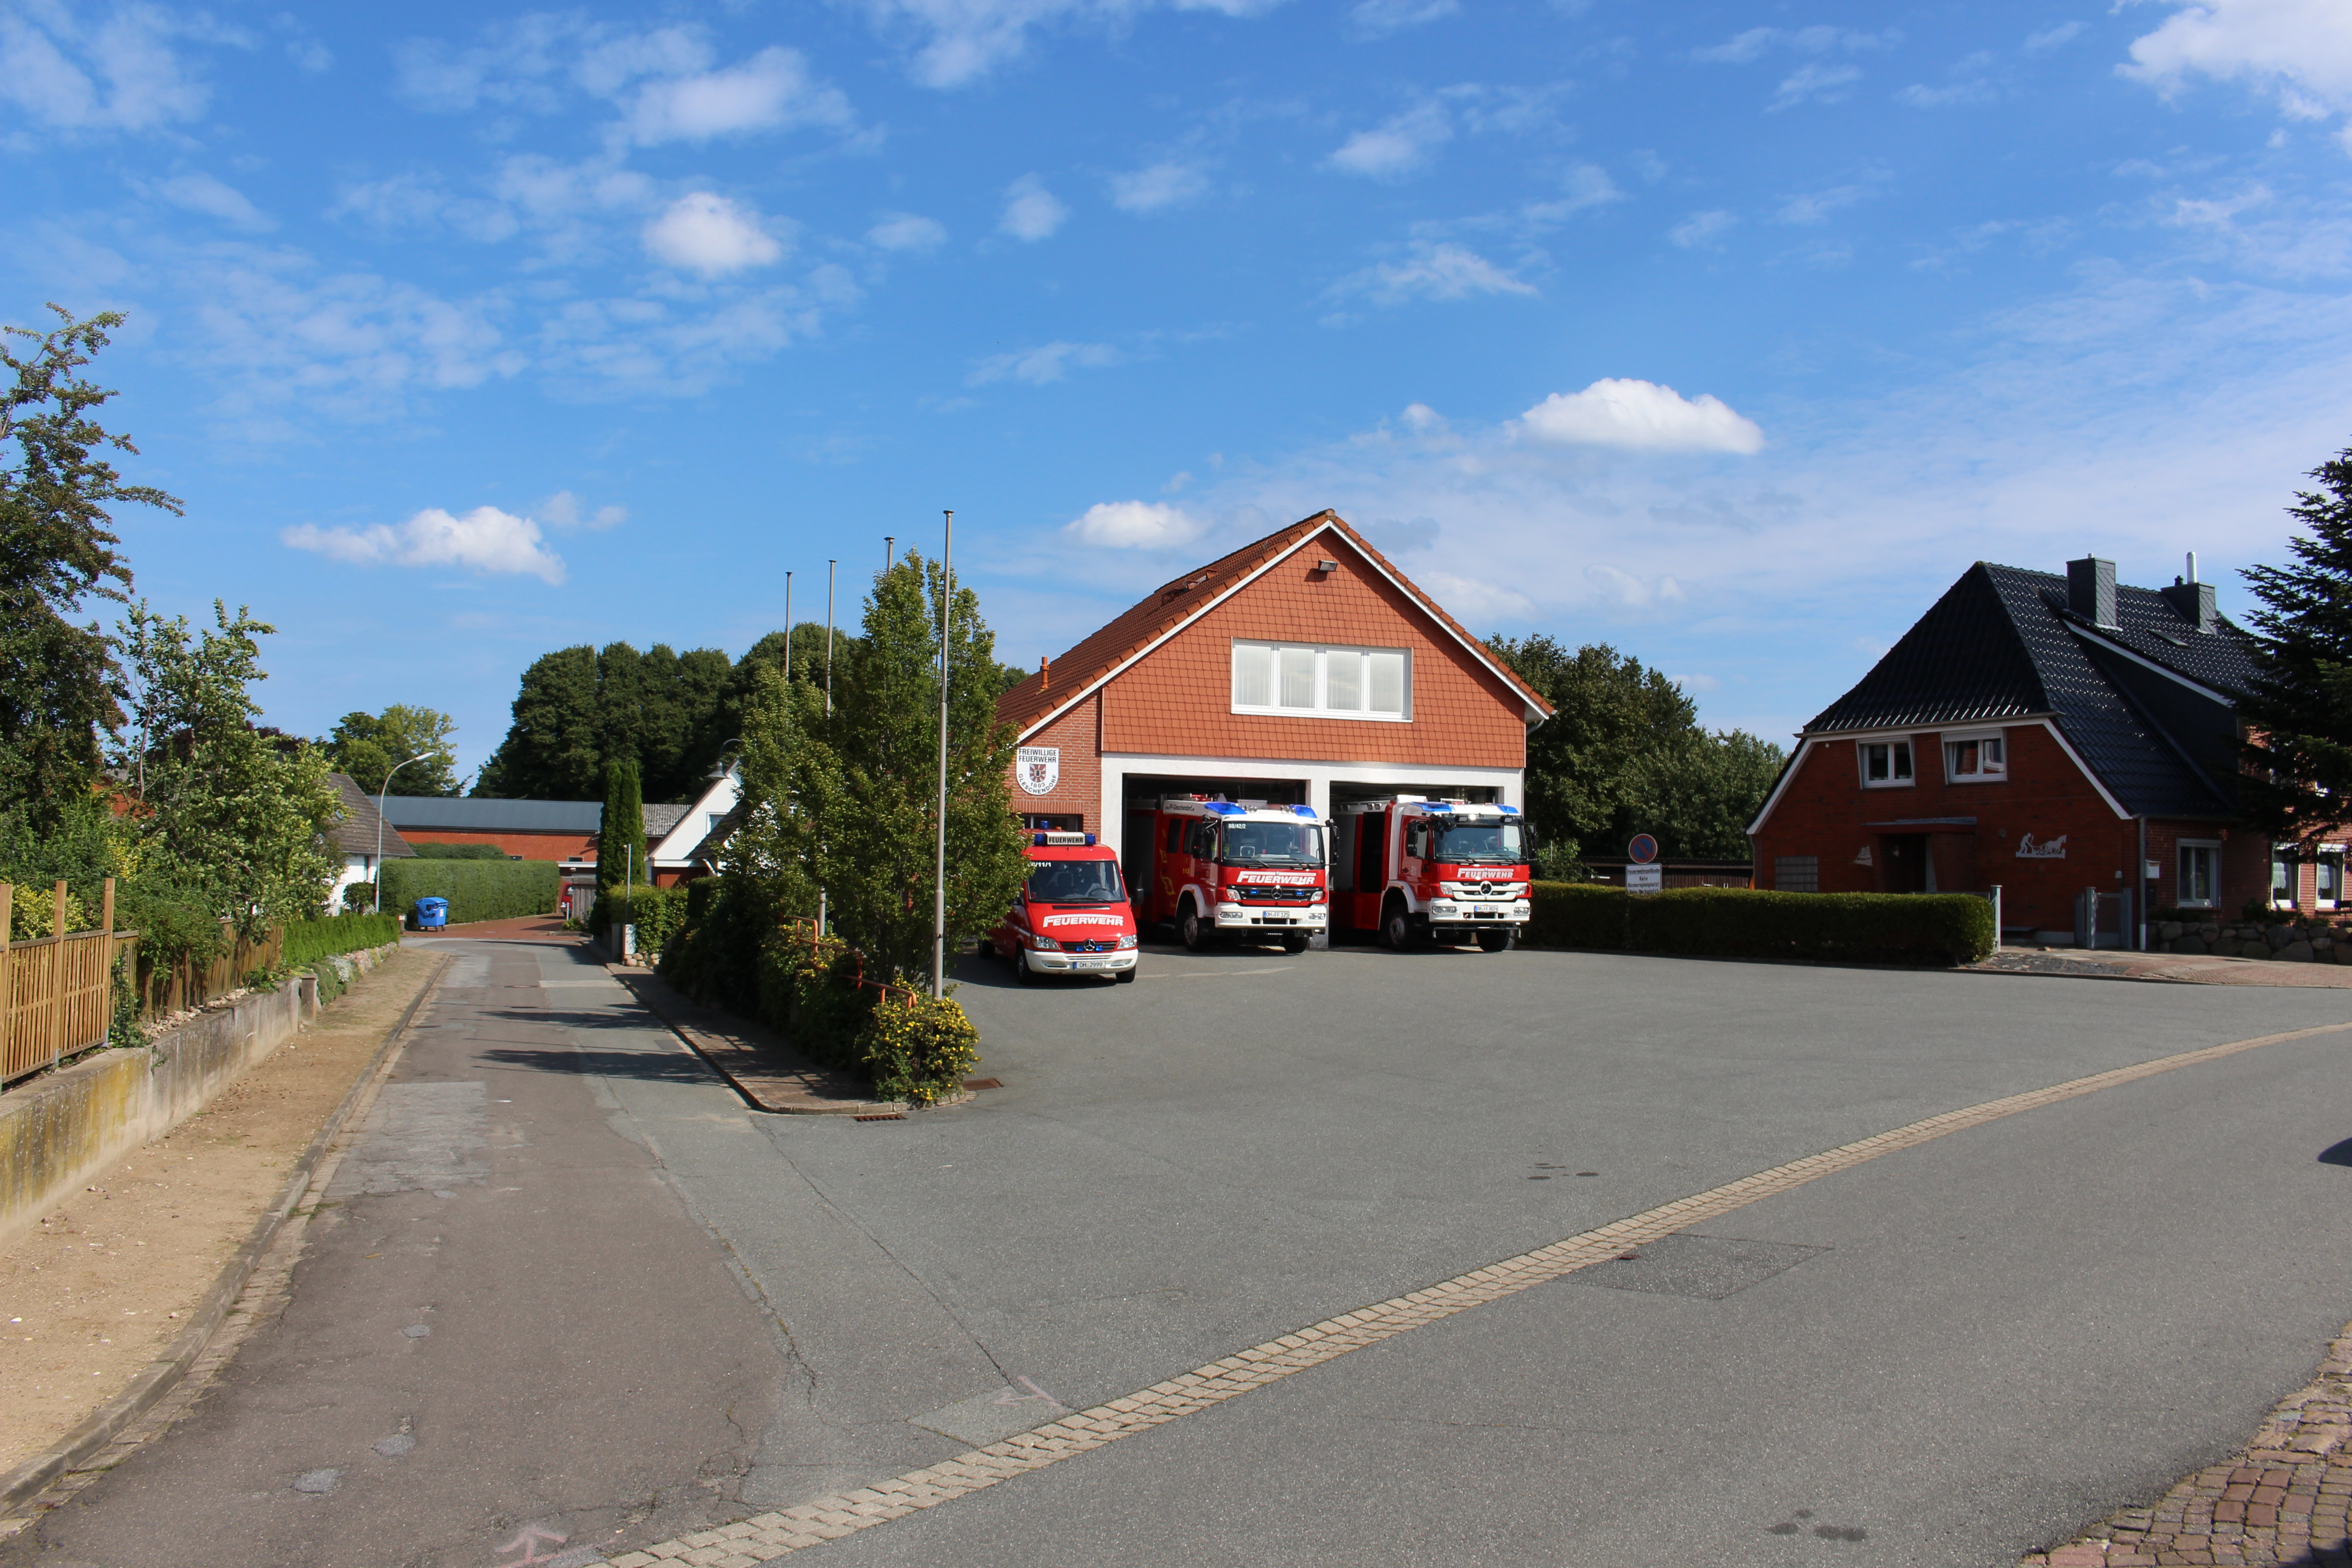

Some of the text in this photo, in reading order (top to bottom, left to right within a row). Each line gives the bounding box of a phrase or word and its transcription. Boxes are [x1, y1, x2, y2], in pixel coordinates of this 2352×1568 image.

[1018, 774, 1057, 794] GLESCHENDORF
[1236, 871, 1317, 884] FEUERWEHR
[1457, 867, 1514, 878] FEUERWEHR
[1043, 913, 1124, 928] FEUERWEHR
